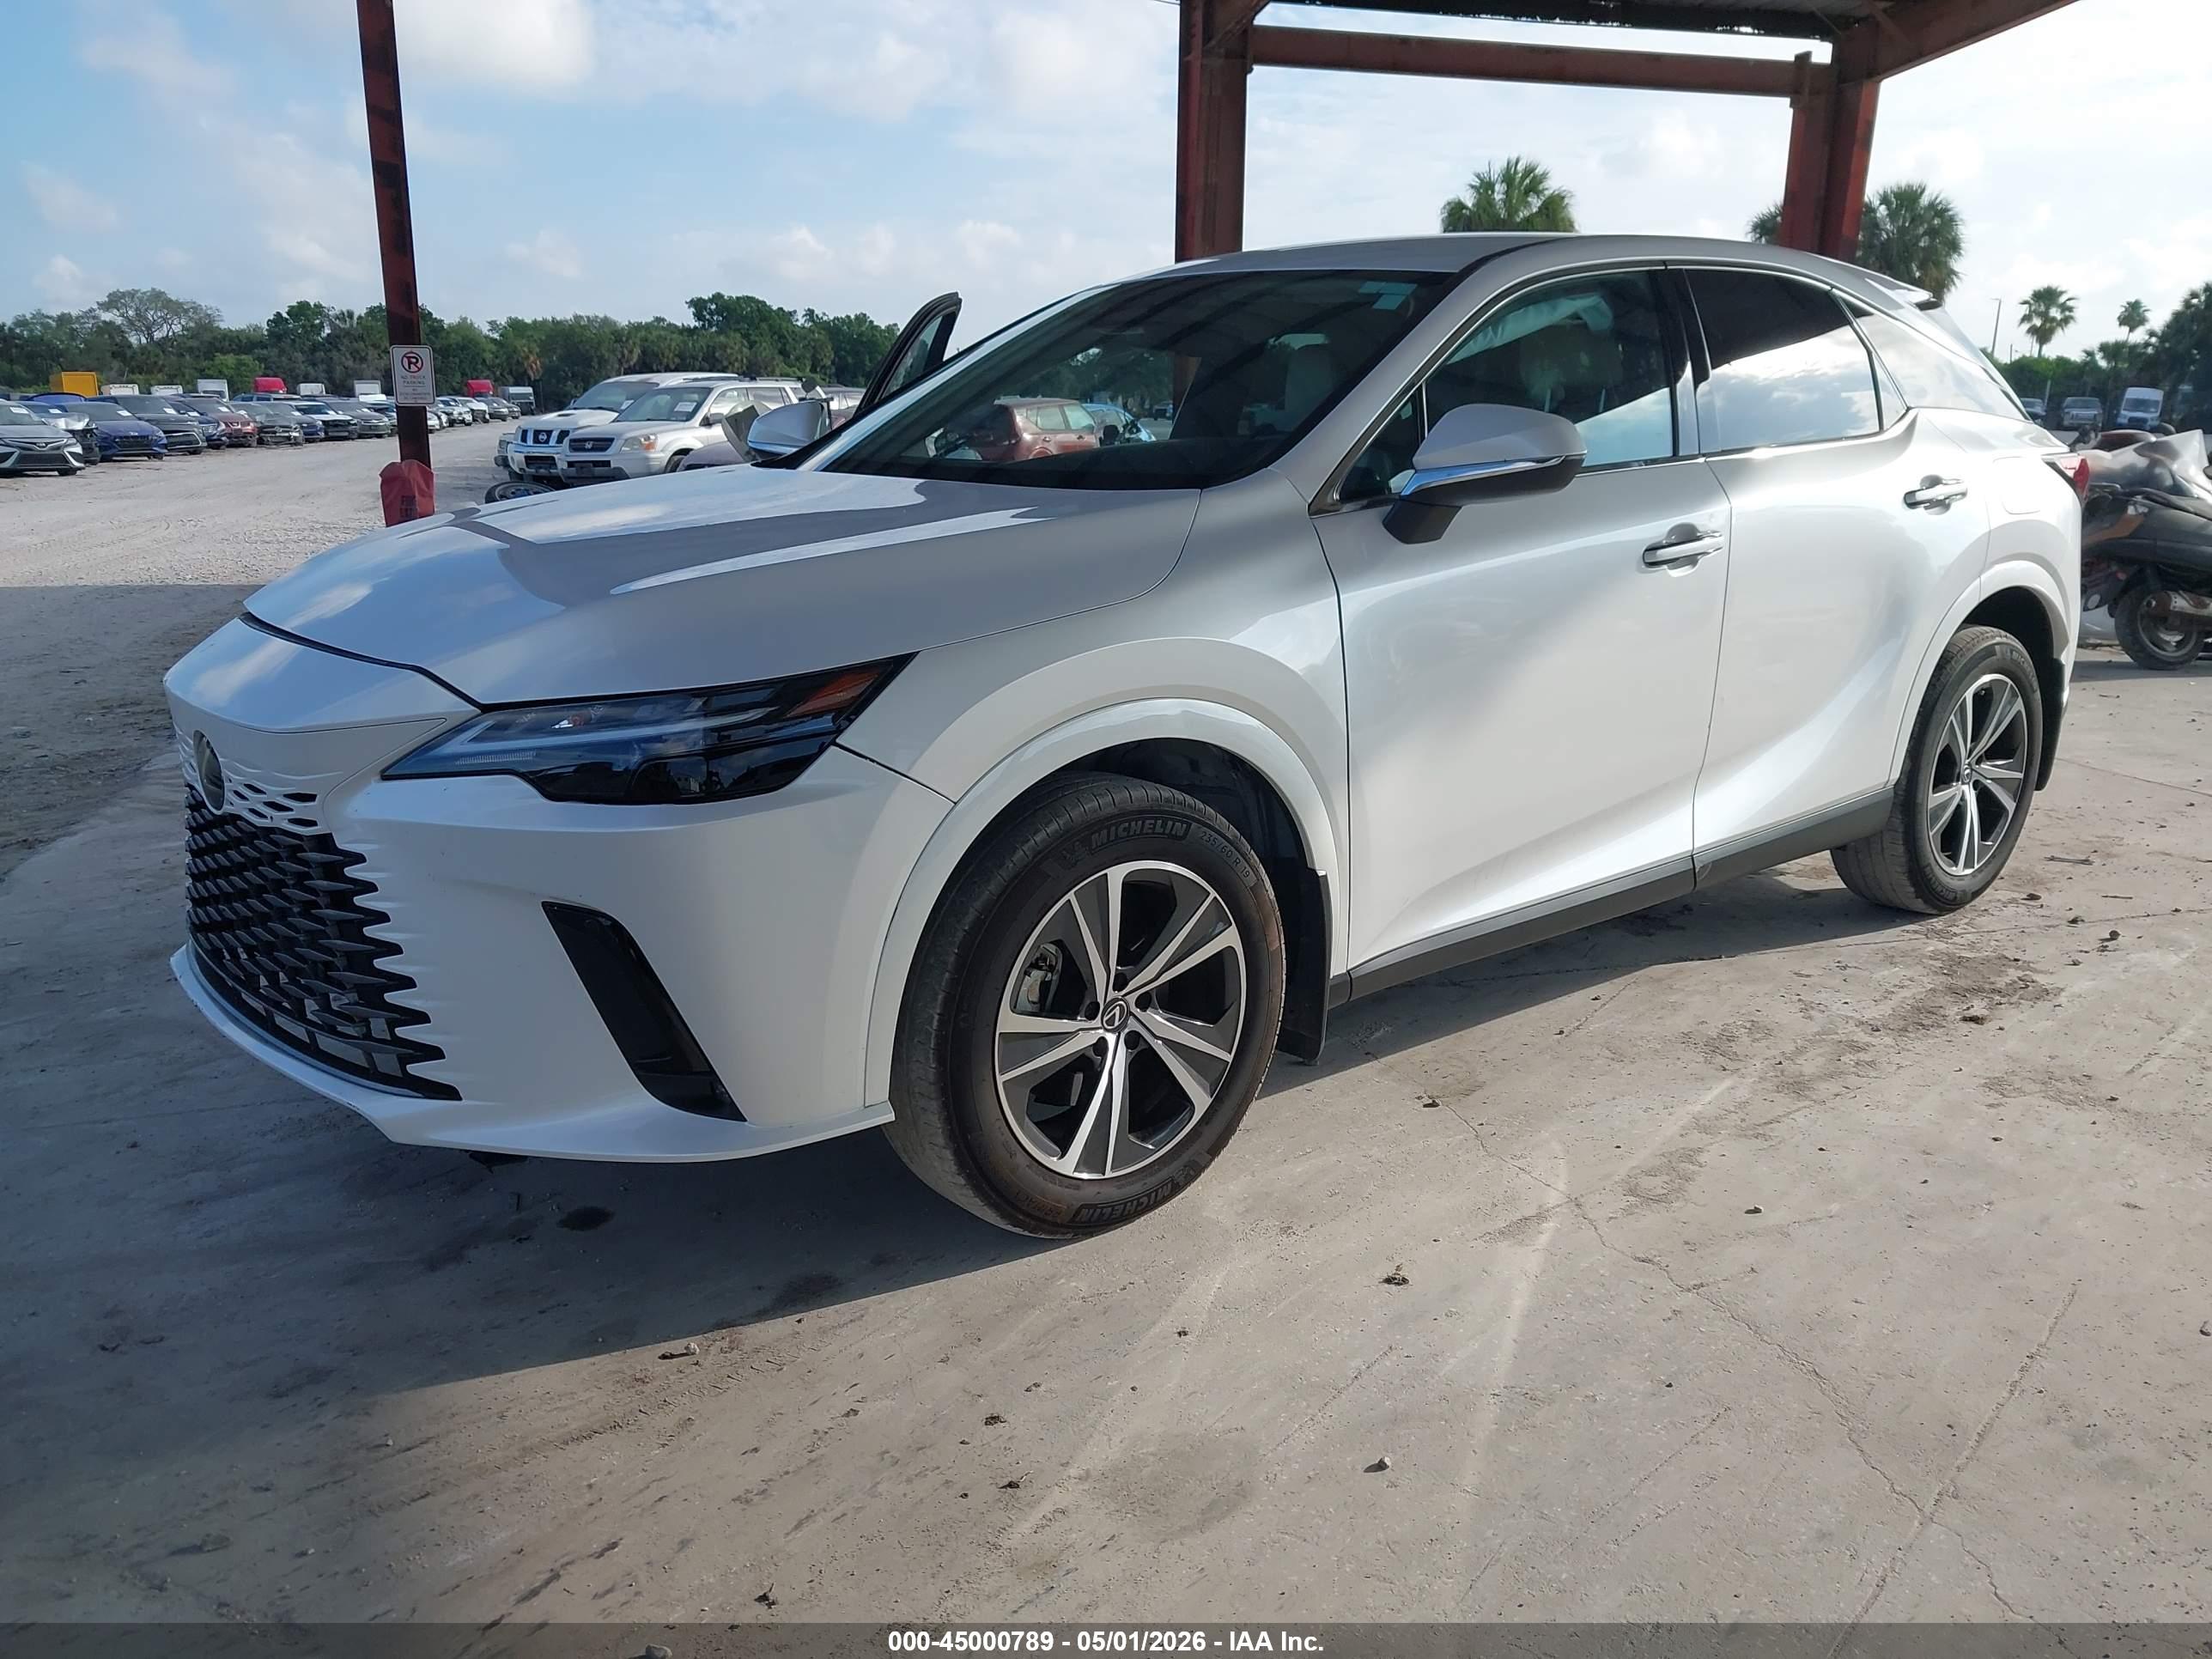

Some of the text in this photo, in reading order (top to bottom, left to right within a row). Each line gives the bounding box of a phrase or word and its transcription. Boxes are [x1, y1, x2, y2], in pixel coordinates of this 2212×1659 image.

[1091, 819, 1188, 848] MICHELIN
[1200, 831, 1234, 858] 235/60
[1242, 867, 1251, 878] 19
[1079, 1181, 1172, 1223] MICHELIN
